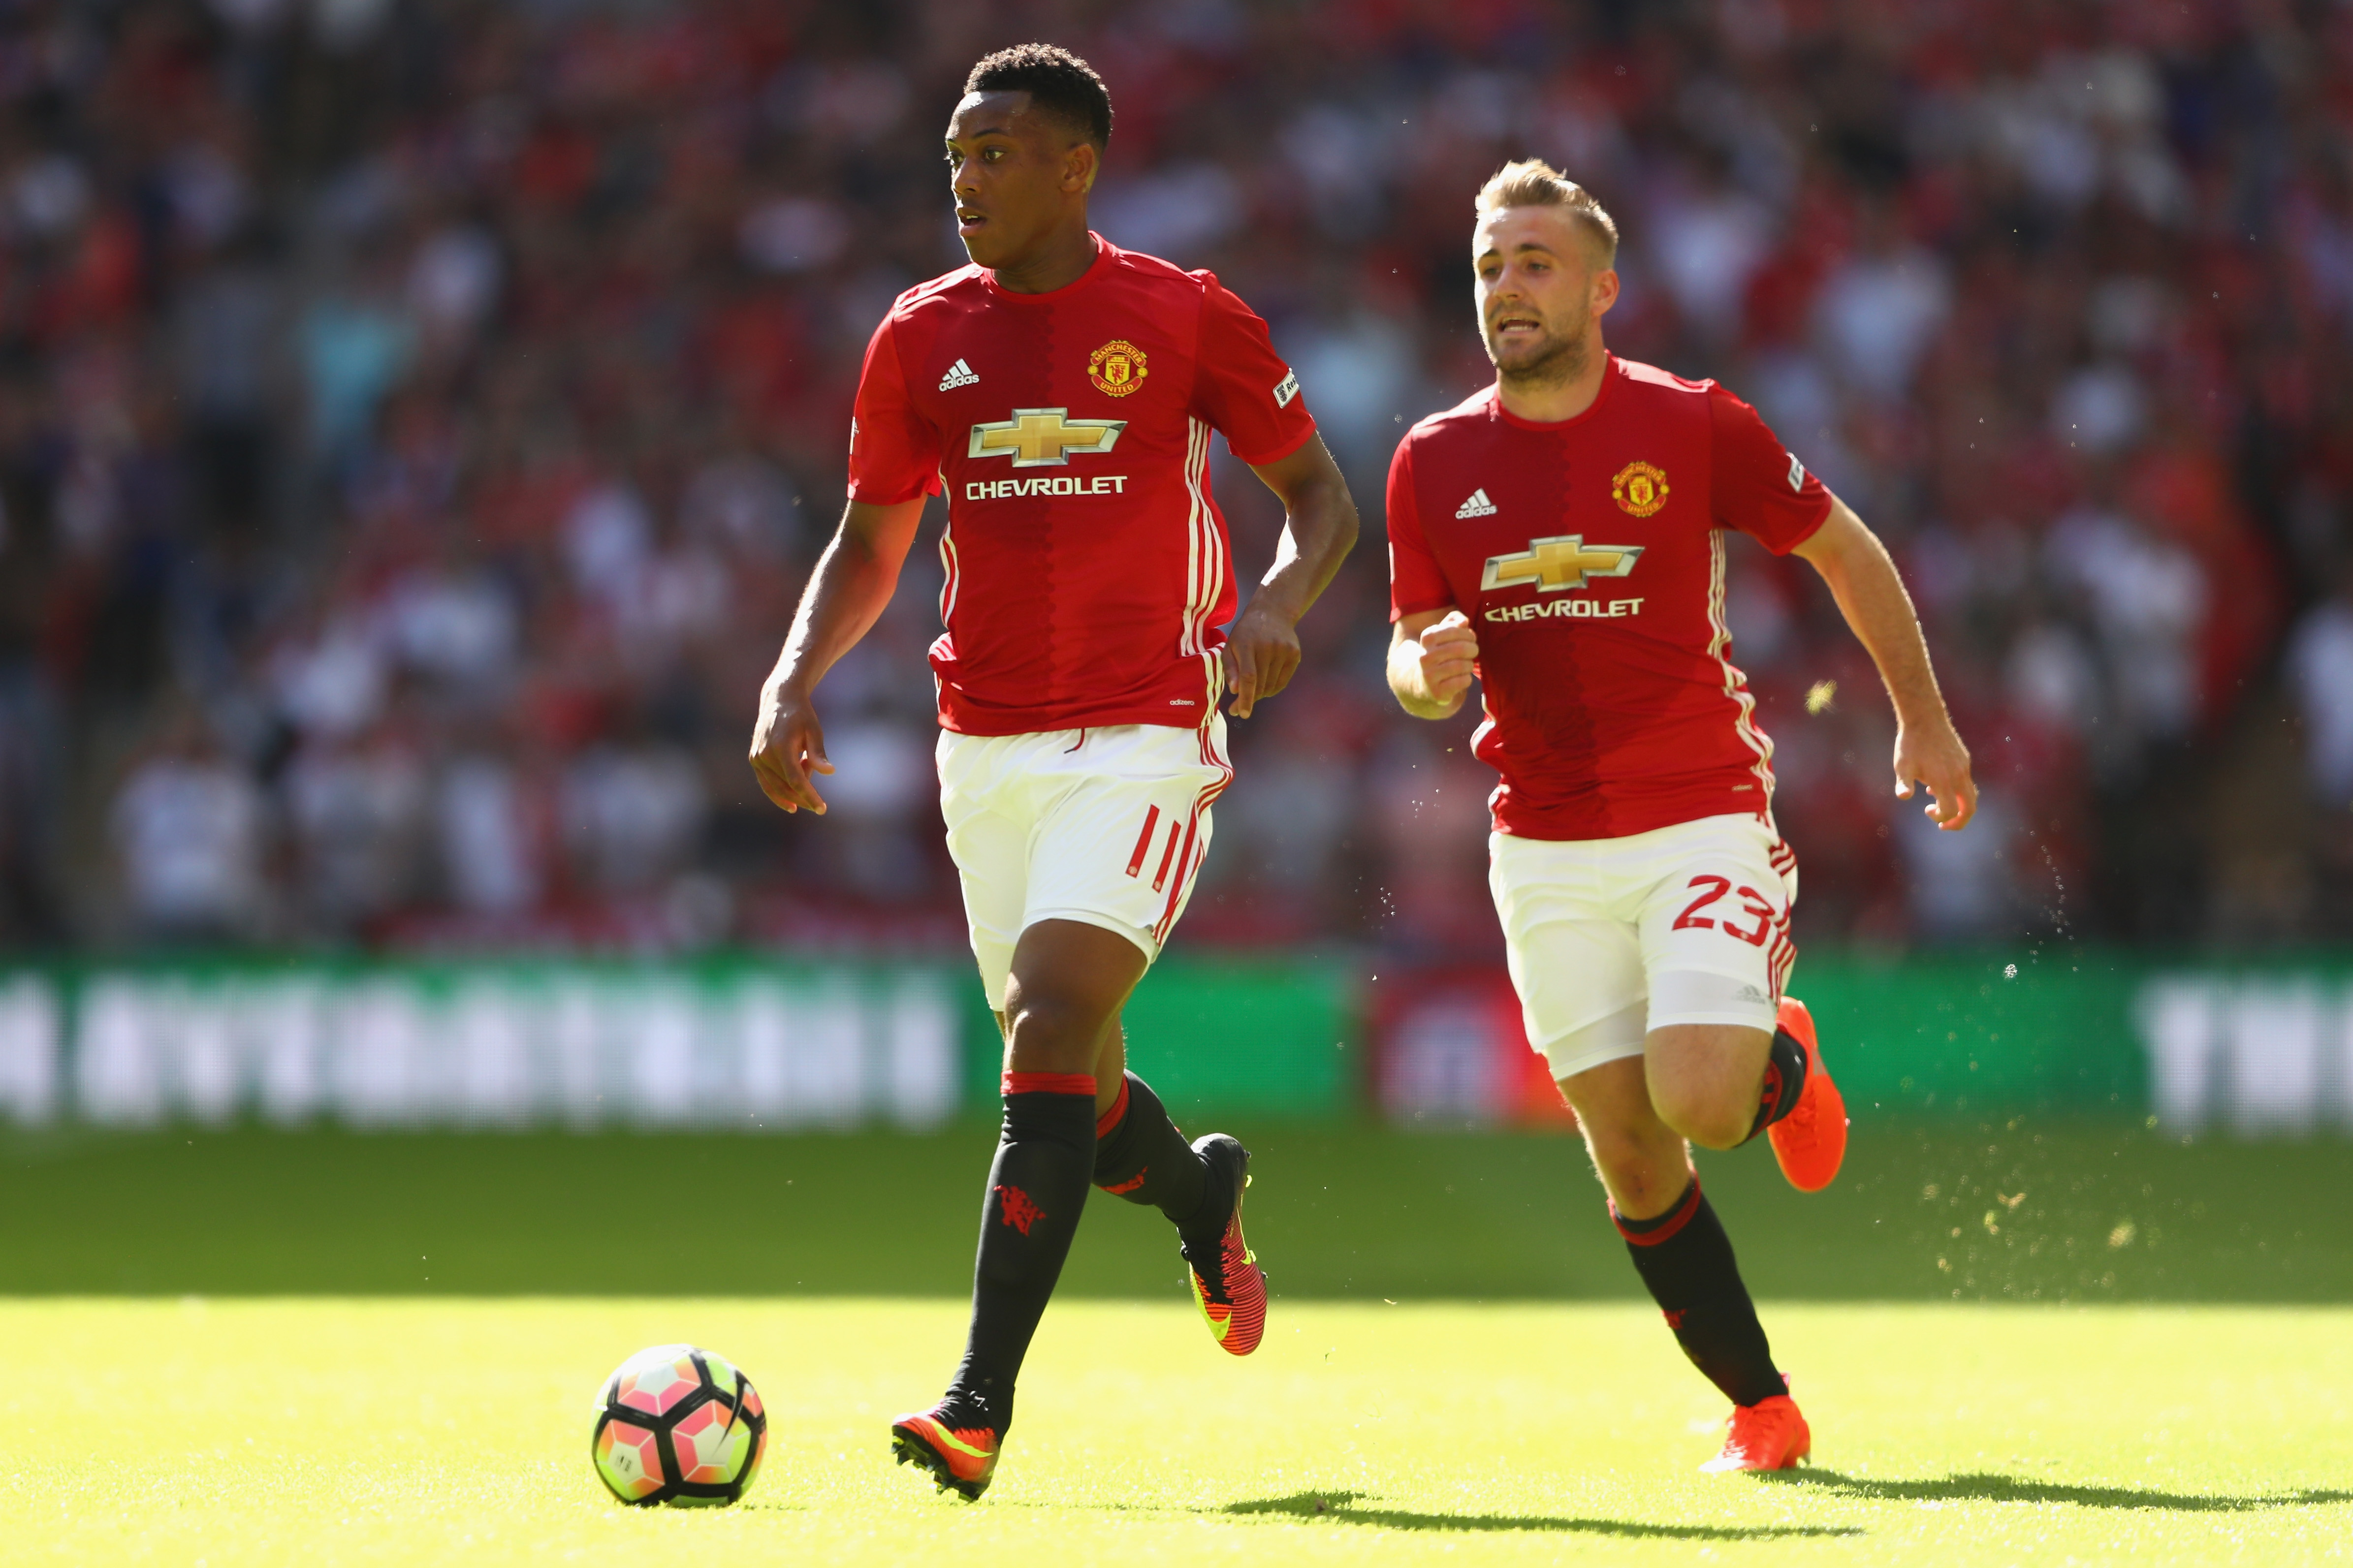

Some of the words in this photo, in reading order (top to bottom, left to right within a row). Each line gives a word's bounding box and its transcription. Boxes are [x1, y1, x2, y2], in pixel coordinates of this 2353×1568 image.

[1094, 345, 1142, 364] MANCHESTER
[938, 375, 980, 392] adidas
[1100, 382, 1134, 393] UNITED
[966, 476, 1128, 501] CHEVROLET
[1455, 505, 1498, 520] adidas
[1485, 597, 1645, 622] CHEVROLET
[1125, 804, 1181, 894] 11
[1672, 874, 1775, 947] 23
